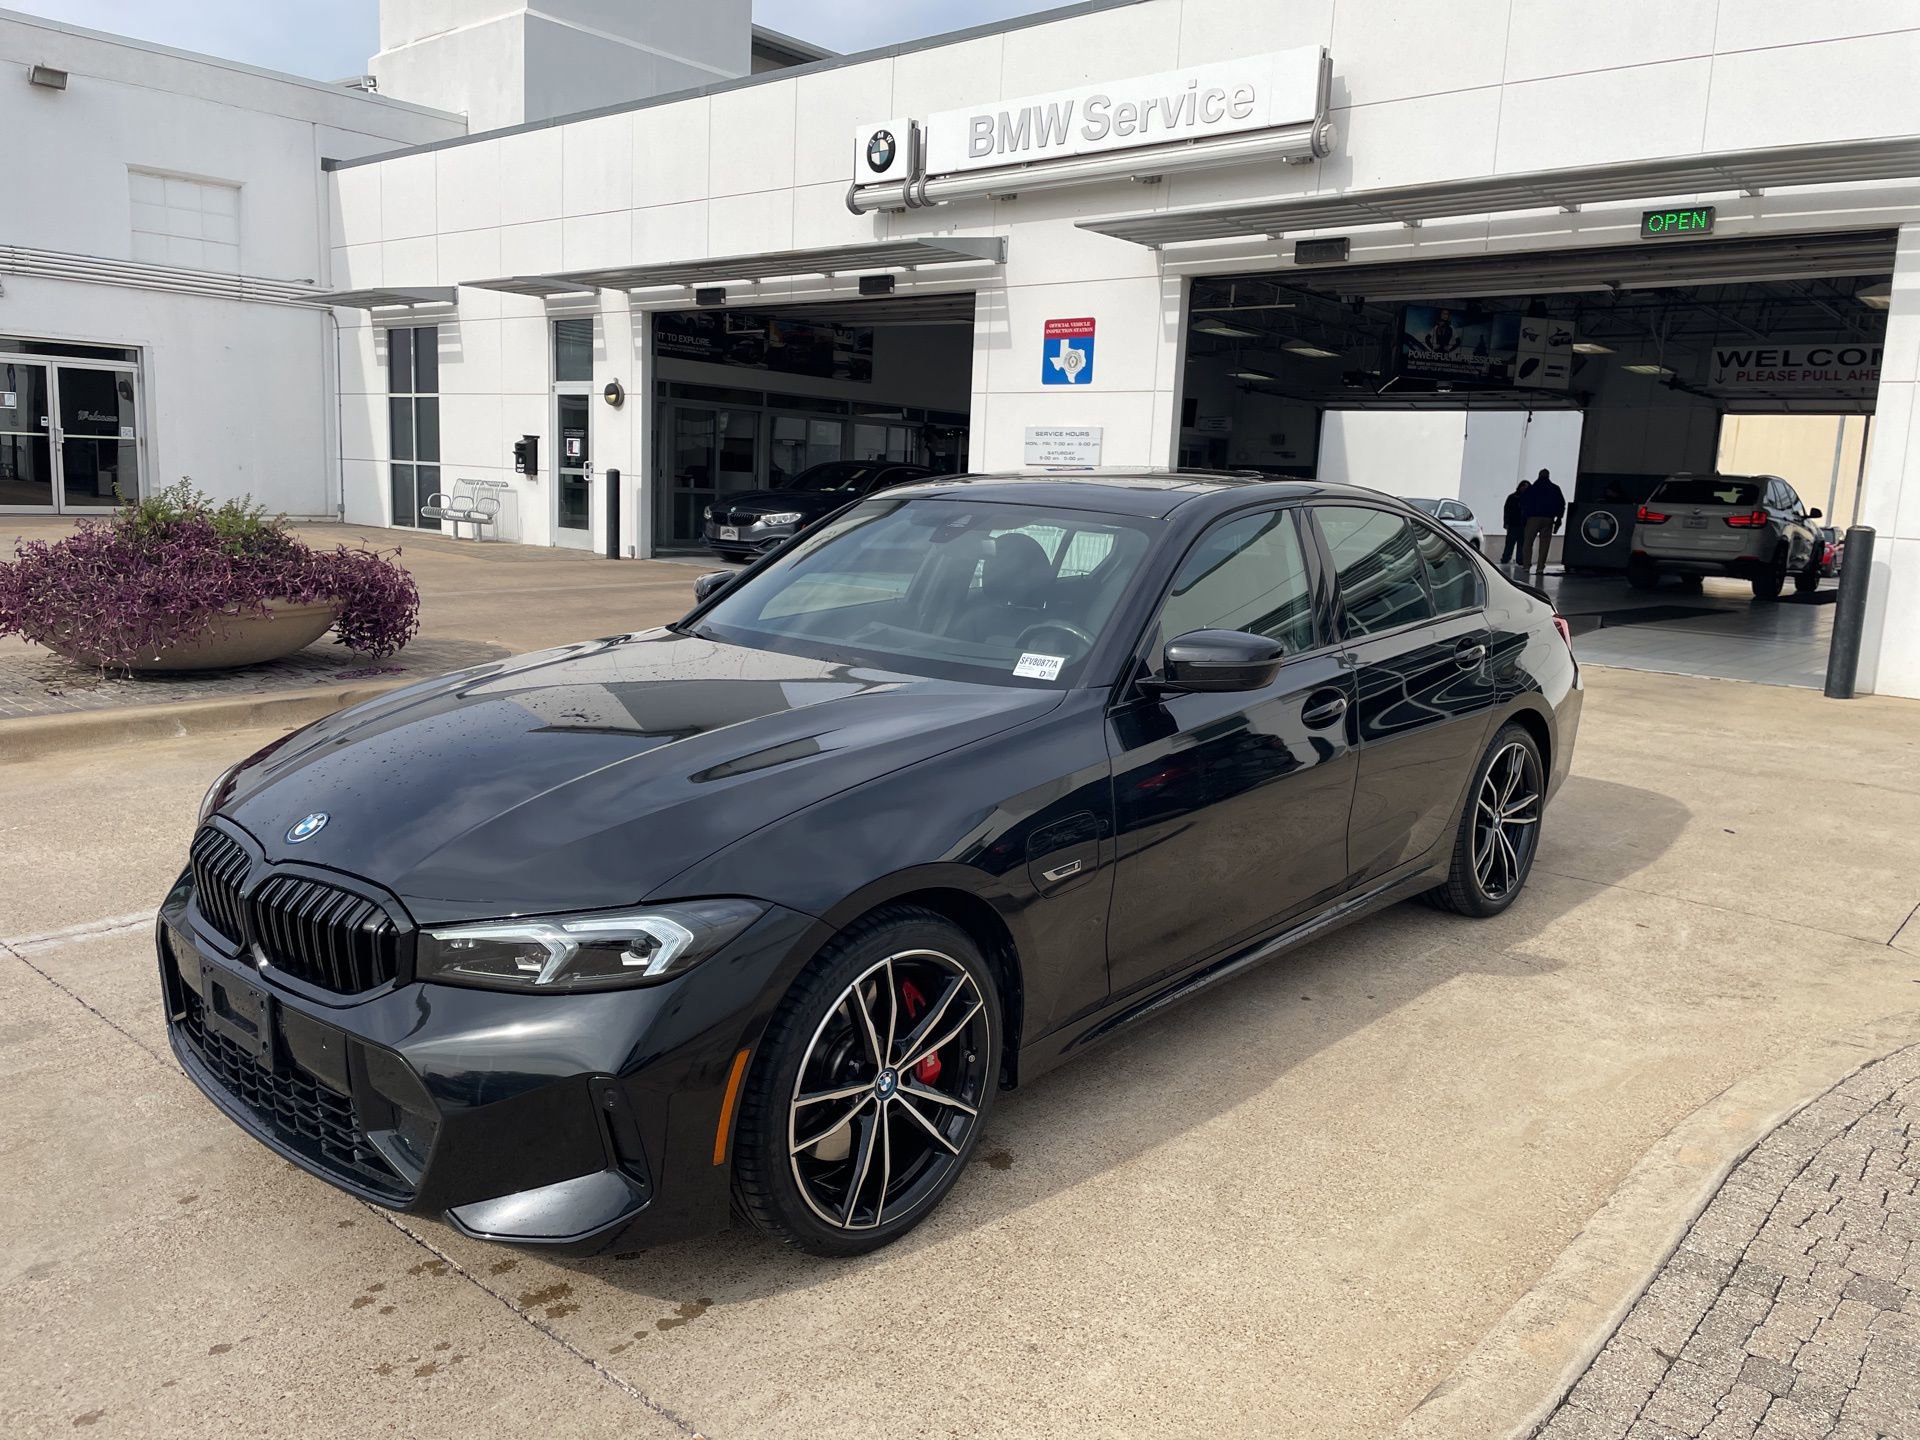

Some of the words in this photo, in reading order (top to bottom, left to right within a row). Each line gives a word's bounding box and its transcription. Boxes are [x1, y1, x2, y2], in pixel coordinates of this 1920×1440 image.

[968, 100, 1074, 158] BMW
[1080, 79, 1255, 142] Service
[1648, 211, 1707, 232] OPEN
[667, 333, 677, 342] TO
[1408, 350, 1449, 361] POWERFUL
[1736, 370, 1797, 382] PLEASE
[1802, 369, 1841, 381] PULL
